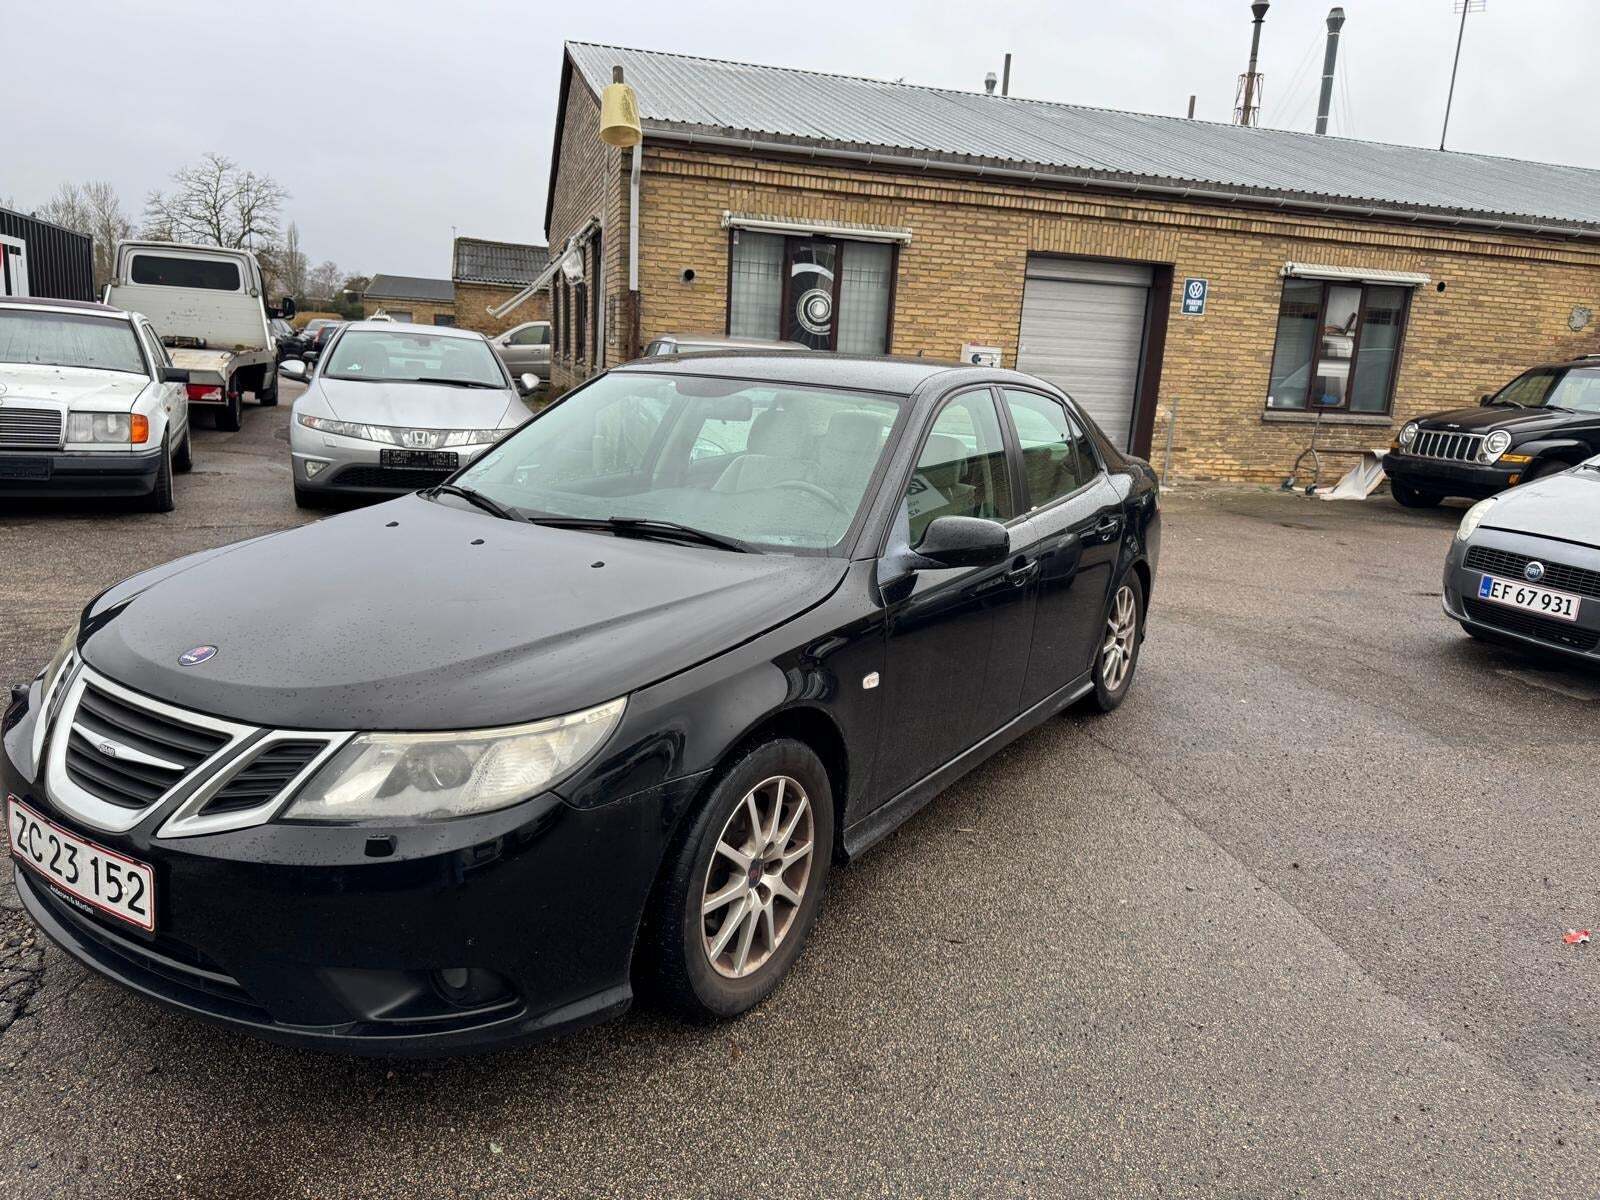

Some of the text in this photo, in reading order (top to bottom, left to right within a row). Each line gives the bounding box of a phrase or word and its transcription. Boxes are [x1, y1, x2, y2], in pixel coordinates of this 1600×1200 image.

[1491, 582, 1572, 616] EF 67 931
[16, 811, 146, 916] ZC 23 152
